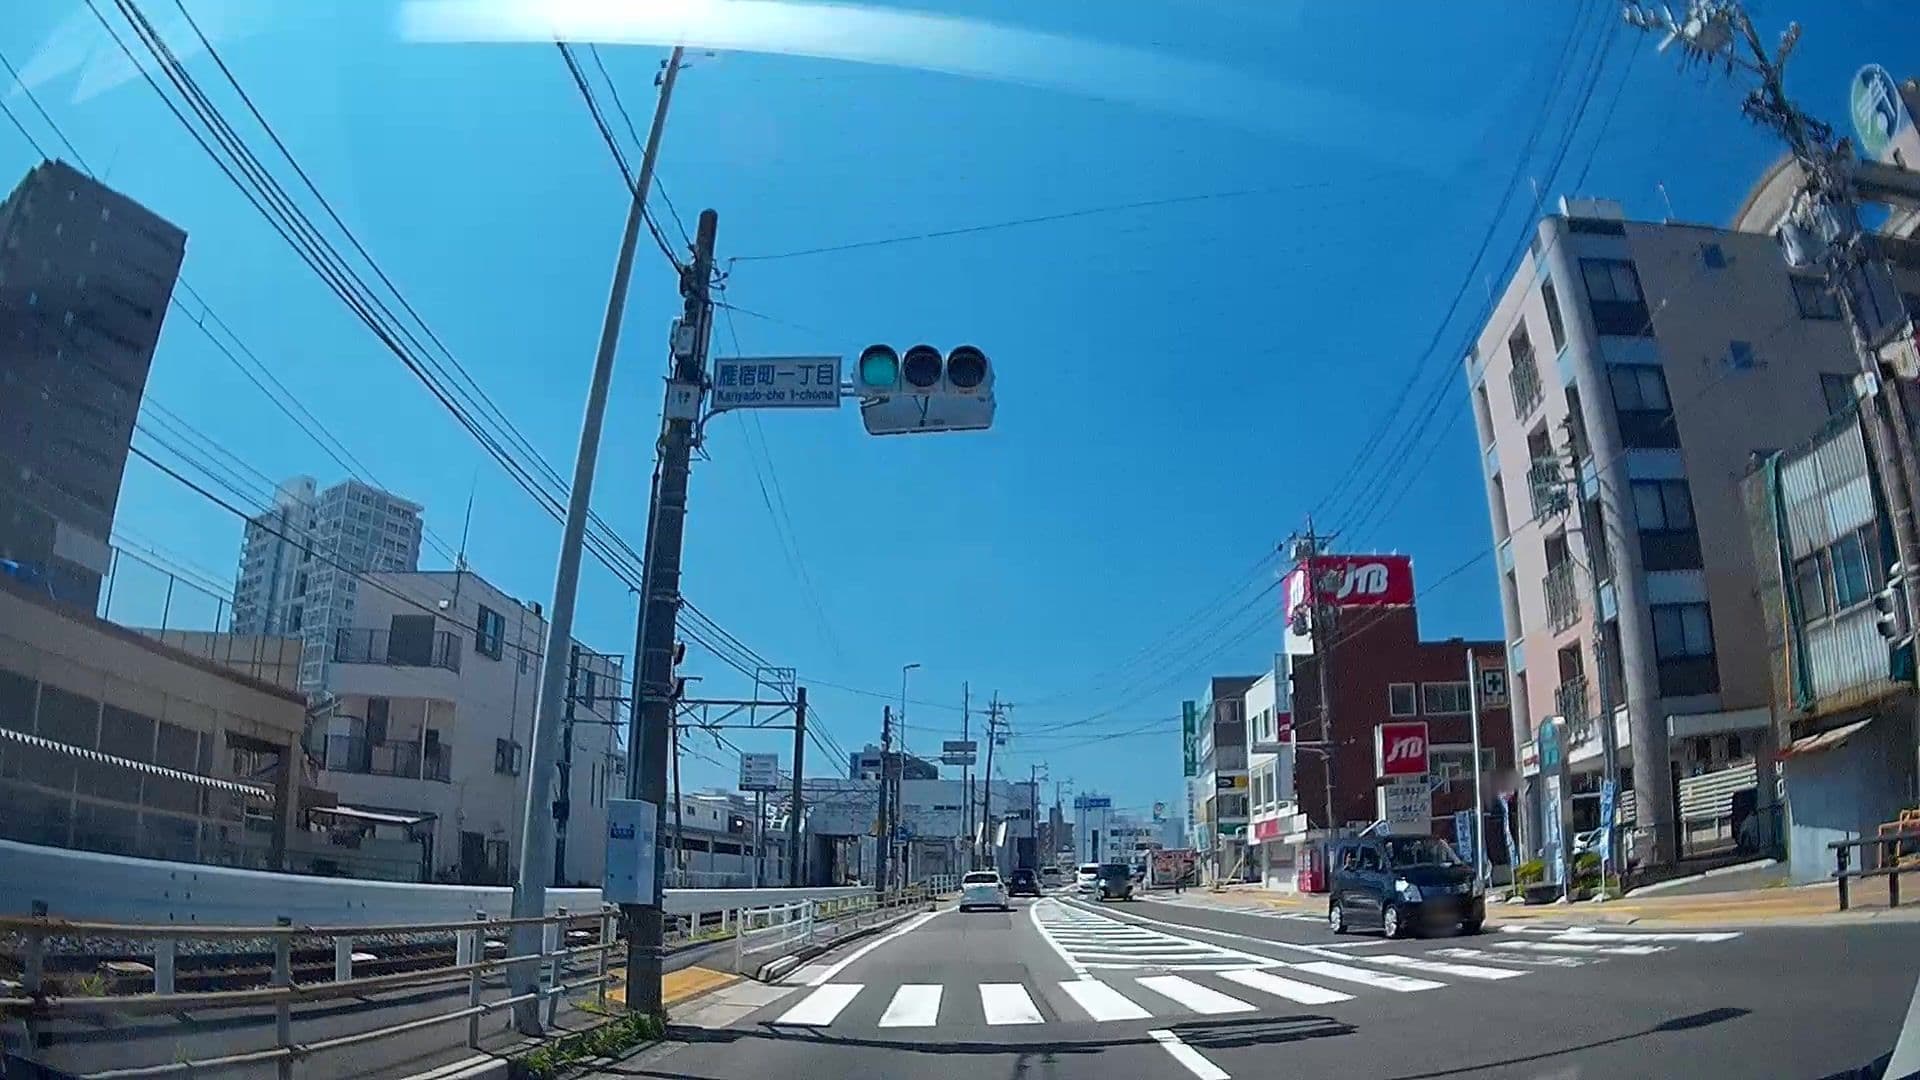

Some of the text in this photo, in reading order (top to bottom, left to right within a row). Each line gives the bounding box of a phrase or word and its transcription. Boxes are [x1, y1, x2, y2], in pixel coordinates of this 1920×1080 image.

[719, 364, 834, 385] 雁宿町一丁目
[1337, 562, 1388, 599] JTB
[1386, 735, 1424, 762] JTB
